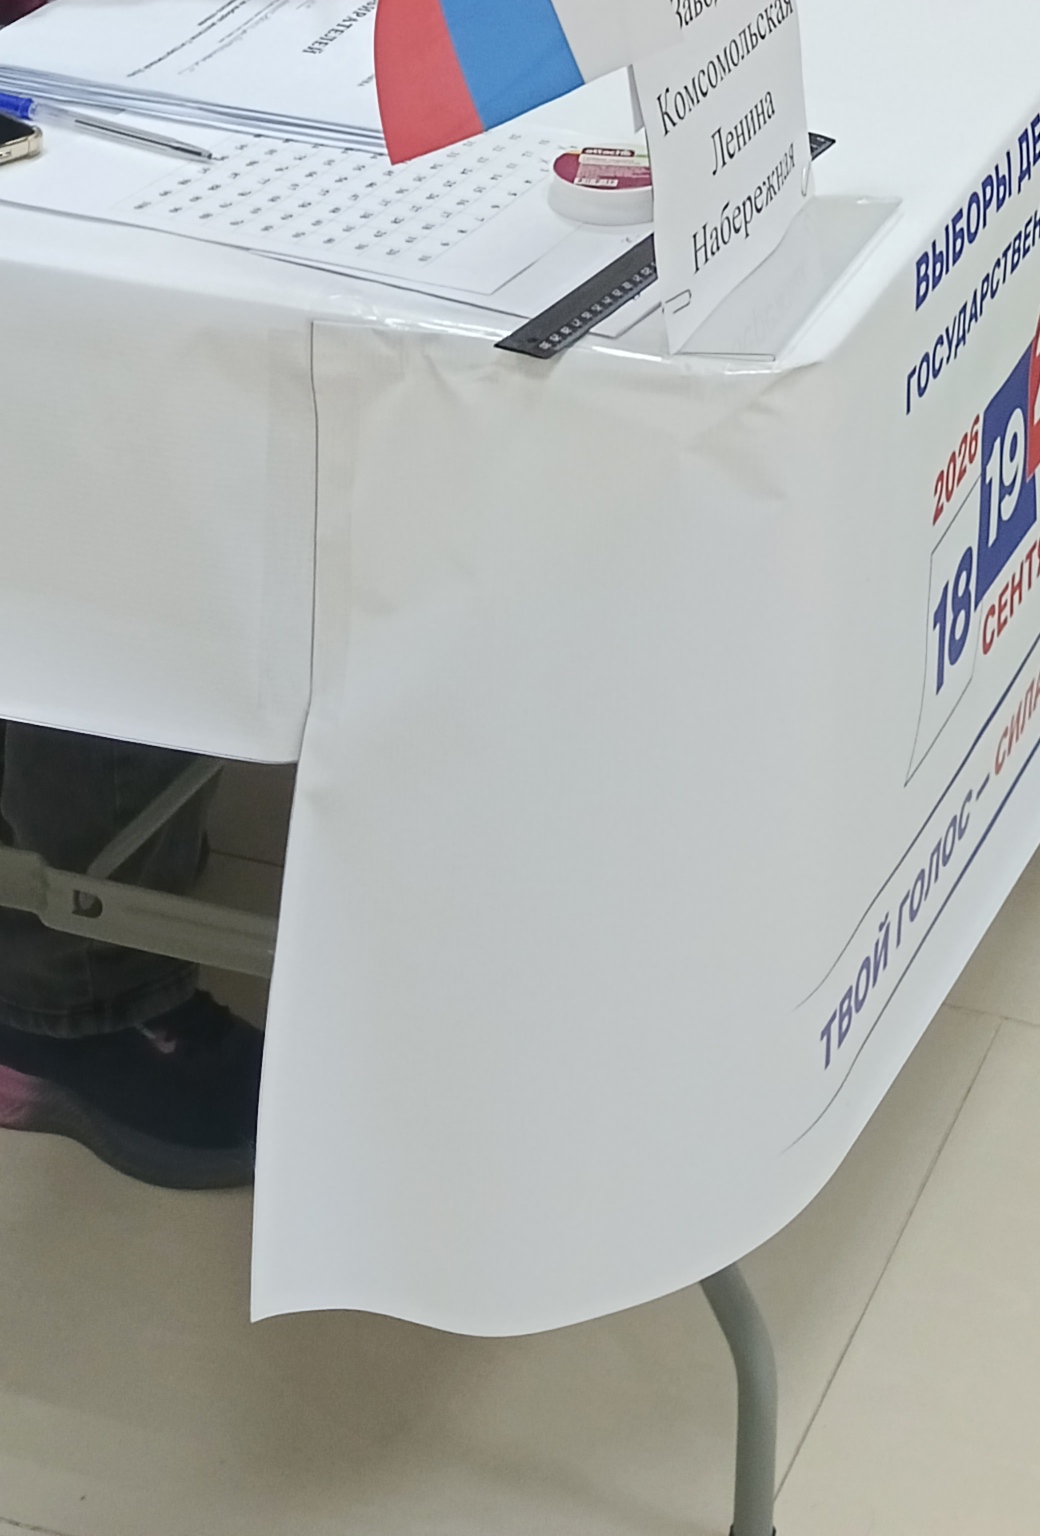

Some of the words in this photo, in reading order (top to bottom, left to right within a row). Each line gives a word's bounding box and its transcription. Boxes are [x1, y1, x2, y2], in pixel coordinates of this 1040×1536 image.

[711, 89, 776, 177] Ленина
[691, 141, 797, 275] Набережная
[915, 149, 1013, 312] ВЫБОРЫ
[932, 414, 980, 527] 2026
[984, 407, 1025, 547] 19
[933, 545, 974, 696] 18
[819, 911, 890, 1071] ТВОЙ
[896, 787, 974, 951] ГОЛОС
